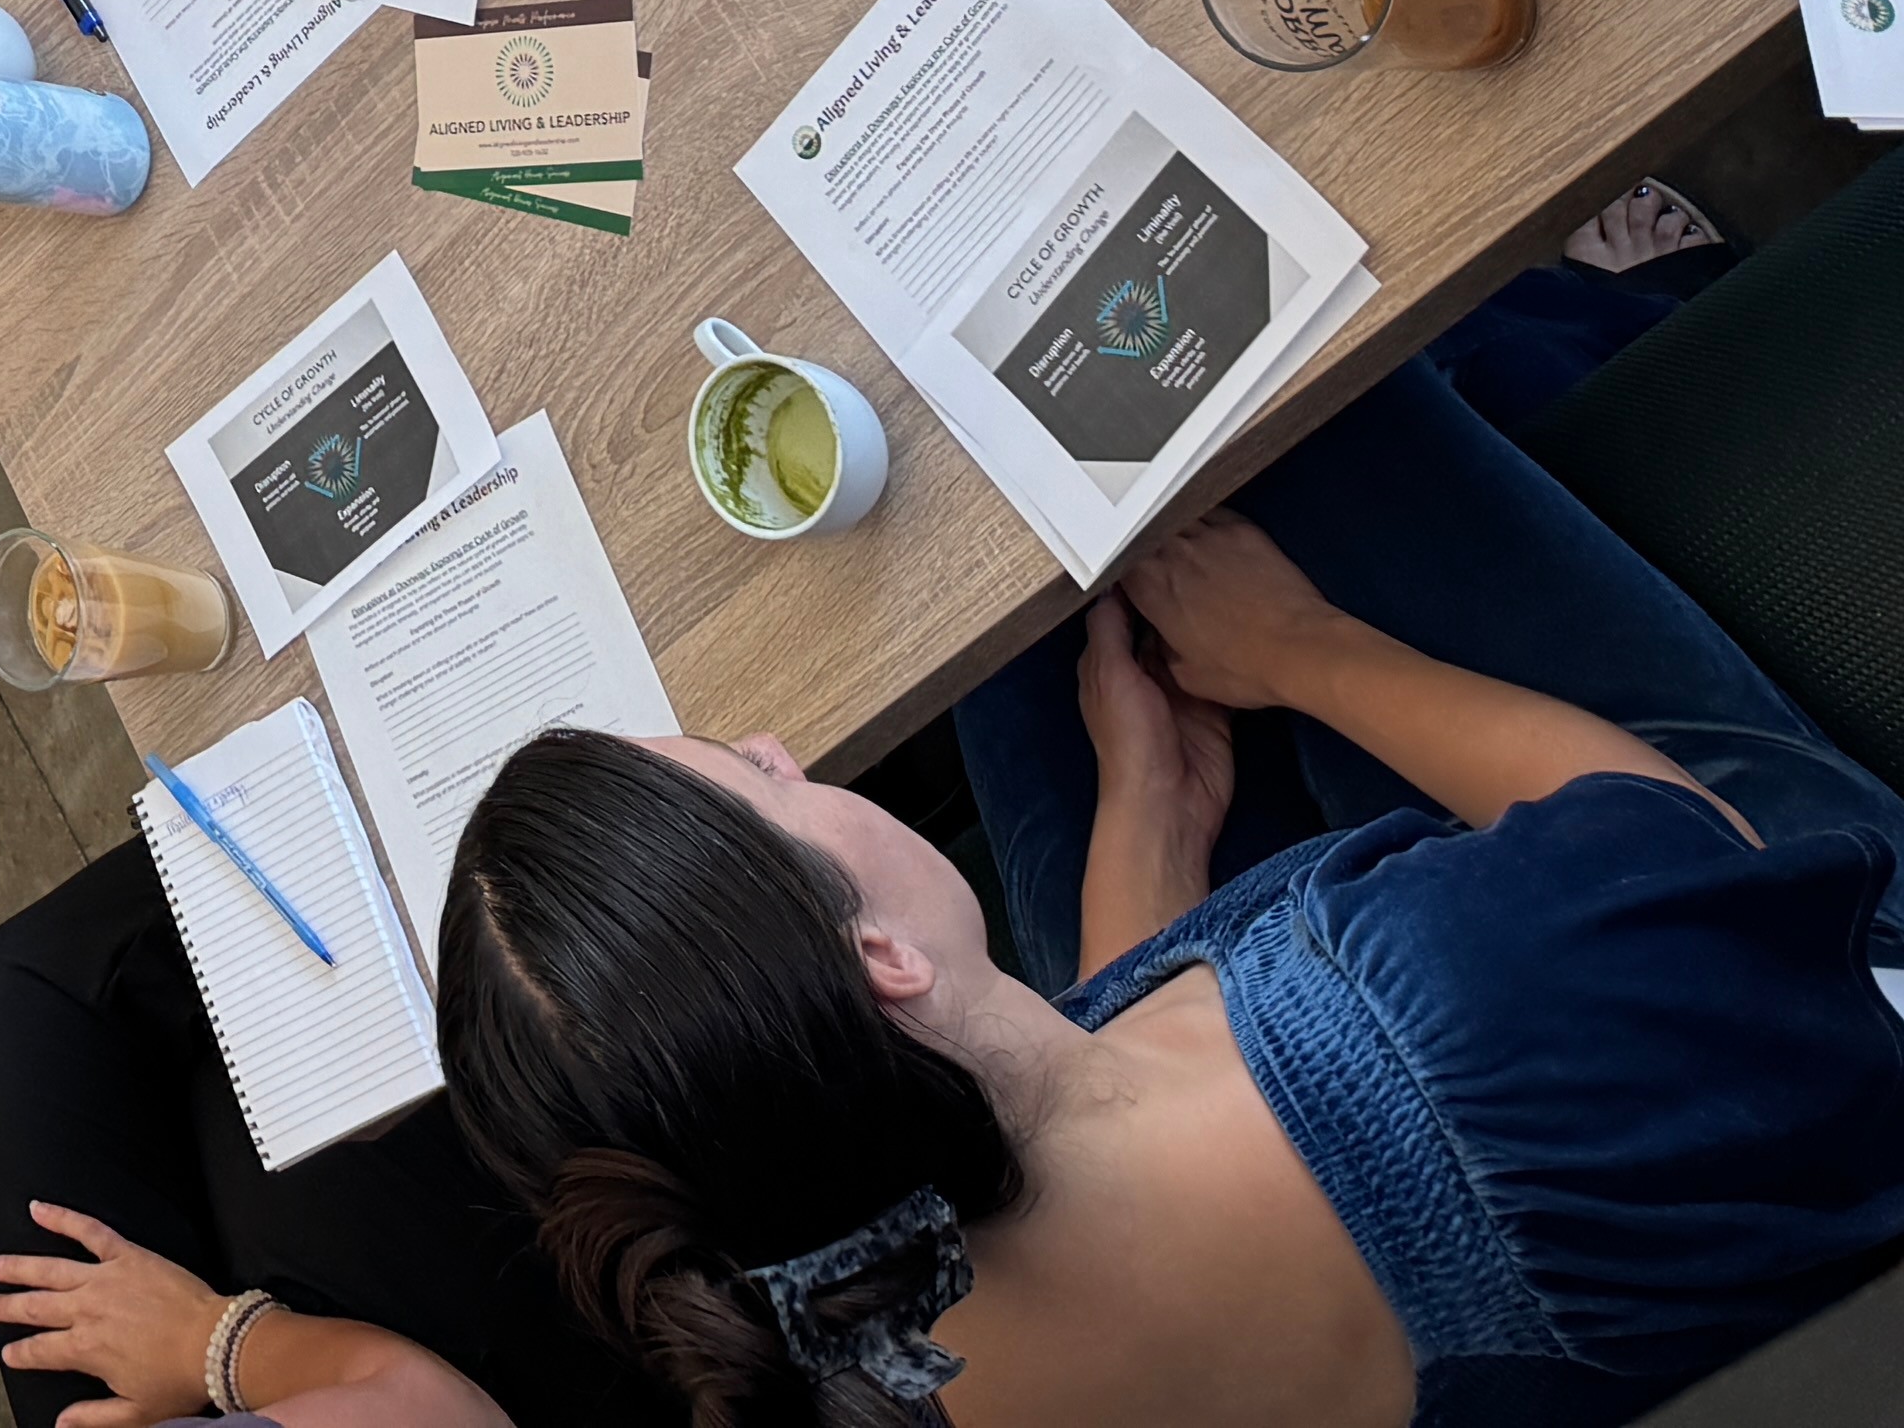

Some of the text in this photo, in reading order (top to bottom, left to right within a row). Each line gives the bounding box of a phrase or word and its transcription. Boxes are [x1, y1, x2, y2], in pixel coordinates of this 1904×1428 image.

[258, 63, 274, 79] &
[269, 34, 303, 68] Living
[817, 75, 864, 132] Aligned
[859, 35, 901, 80] Living
[890, 18, 914, 41] &
[207, 75, 262, 129] Leadership
[430, 112, 630, 135] ALIGNED LIVING & LEADERSHIP
[1008, 183, 1104, 298] CYCLE OF GROWTH
[1137, 194, 1180, 242] Liminality
[1028, 211, 1108, 305] Understanding Change
[1029, 329, 1073, 377] Disruption
[1150, 329, 1196, 379] Expansion
[253, 350, 336, 425] CYCLE OF GROWTH
[255, 460, 291, 493] Disruption
[437, 505, 452, 522] &
[451, 468, 518, 514] Leadership
[338, 487, 375, 520] Expansion
